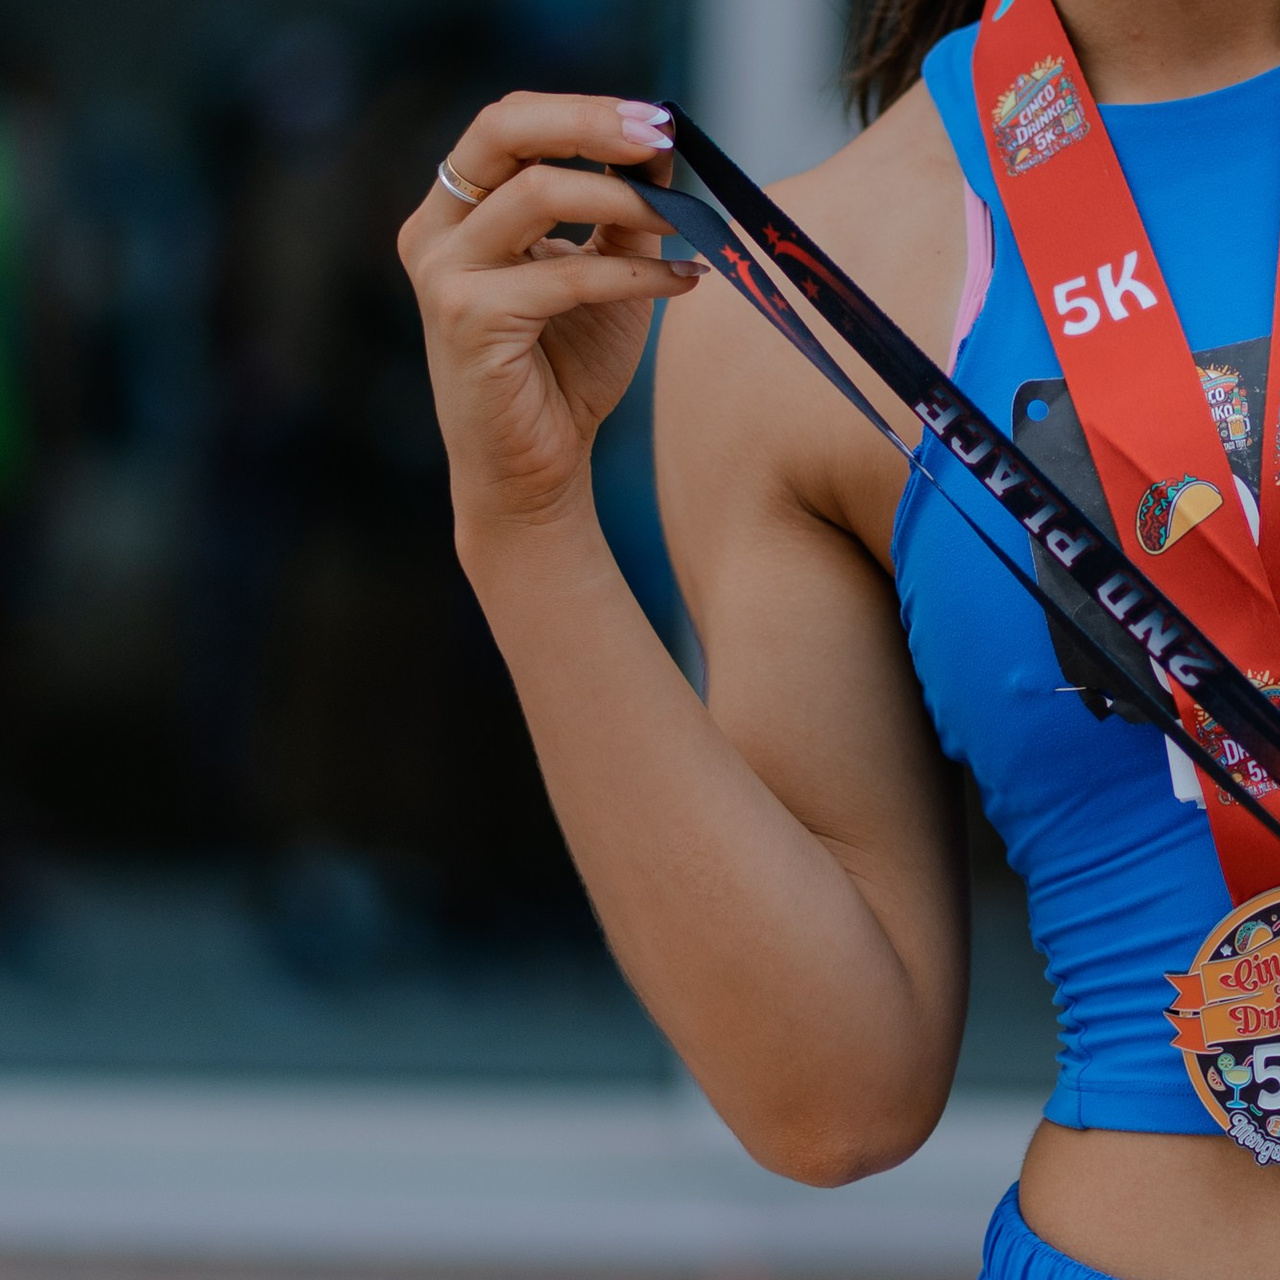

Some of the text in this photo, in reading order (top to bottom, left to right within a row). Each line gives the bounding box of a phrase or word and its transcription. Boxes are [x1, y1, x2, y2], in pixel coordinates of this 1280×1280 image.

[1015, 99, 1066, 145] DRINKO
[1018, 84, 1056, 126] CINCO
[1034, 128, 1057, 151] 5K
[1053, 250, 1158, 336] 5K
[914, 386, 1098, 568] PLACE
[1097, 571, 1217, 687] 2ND
